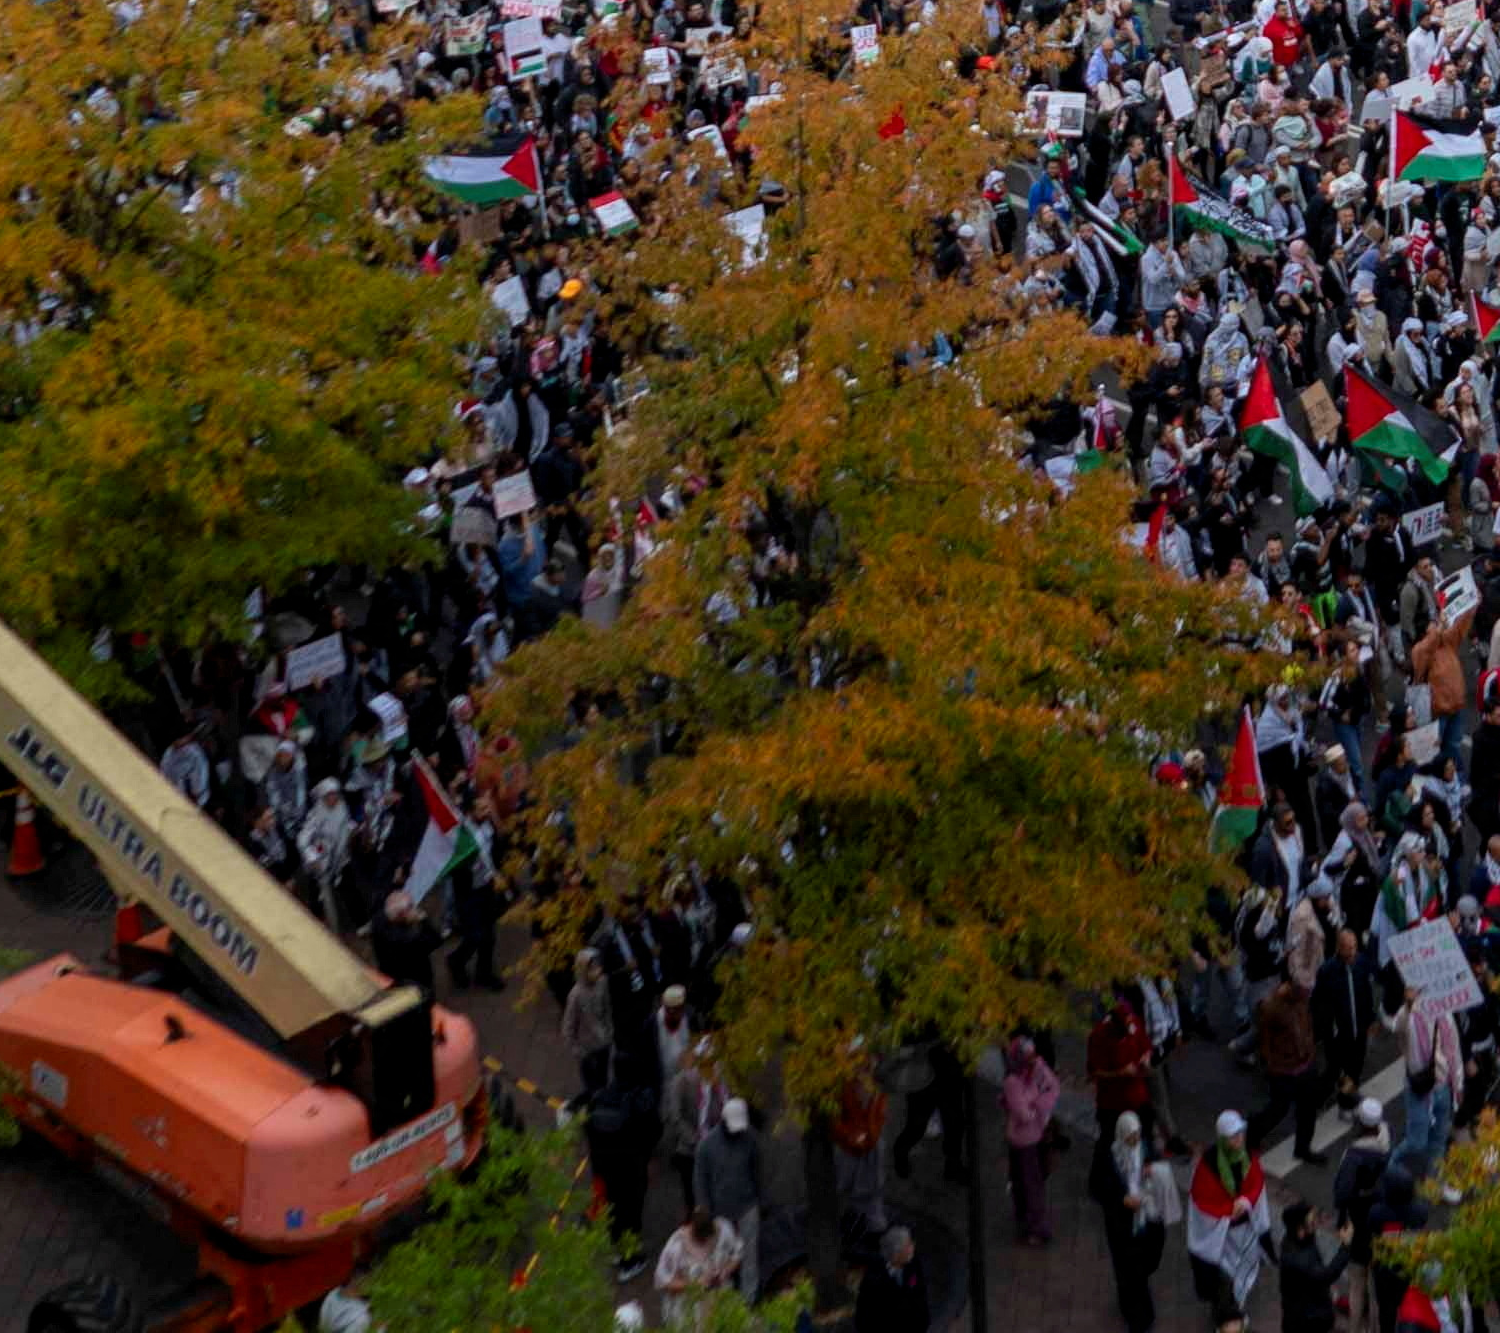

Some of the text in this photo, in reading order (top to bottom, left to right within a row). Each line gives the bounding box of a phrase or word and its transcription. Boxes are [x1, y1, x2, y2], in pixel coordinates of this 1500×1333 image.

[7, 724, 260, 977] JLG ULTRA BOOM
